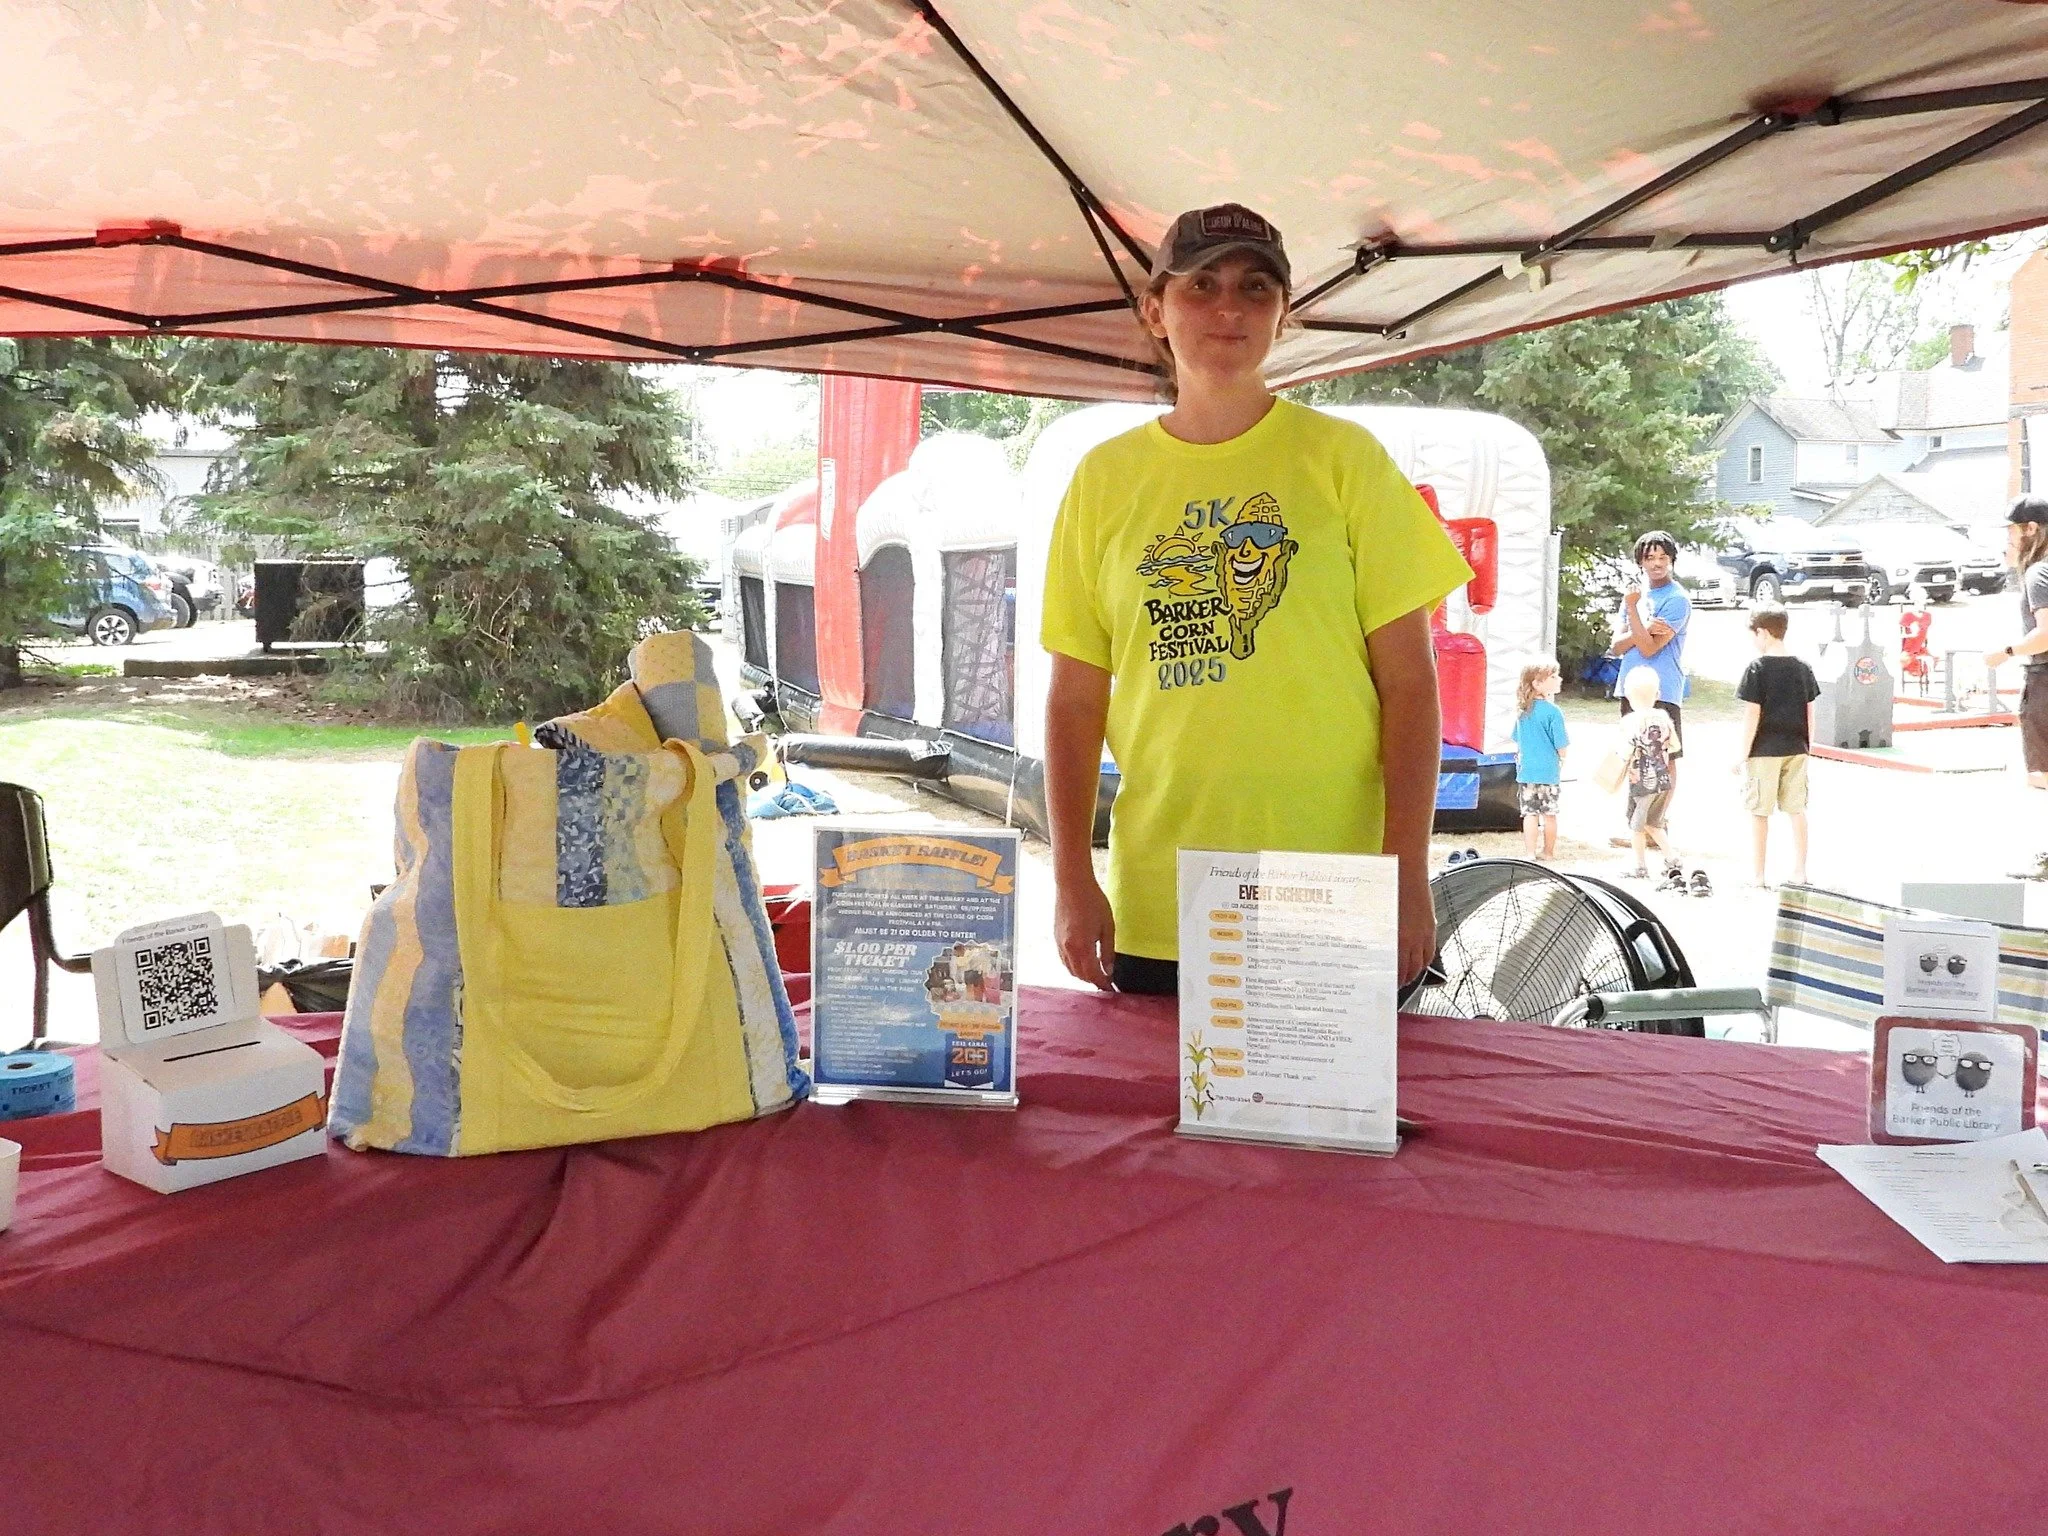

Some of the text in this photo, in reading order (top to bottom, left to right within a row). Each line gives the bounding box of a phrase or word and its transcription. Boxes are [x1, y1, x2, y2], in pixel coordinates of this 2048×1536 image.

[1183, 496, 1236, 530] 5K
[1145, 597, 1233, 626] BARKER
[1159, 620, 1215, 640] CORN
[1149, 636, 1229, 662] FESTIVAL
[1158, 656, 1226, 690] 2025
[1239, 884, 1334, 904] EVENT SCHEDULE
[911, 929, 937, 937] OLDER
[834, 940, 918, 956] $1.00 PER
[844, 954, 910, 968] TICKET
[1911, 1103, 1982, 1117] Friends of the
[1892, 1114, 2002, 1132] Barker Public Library
